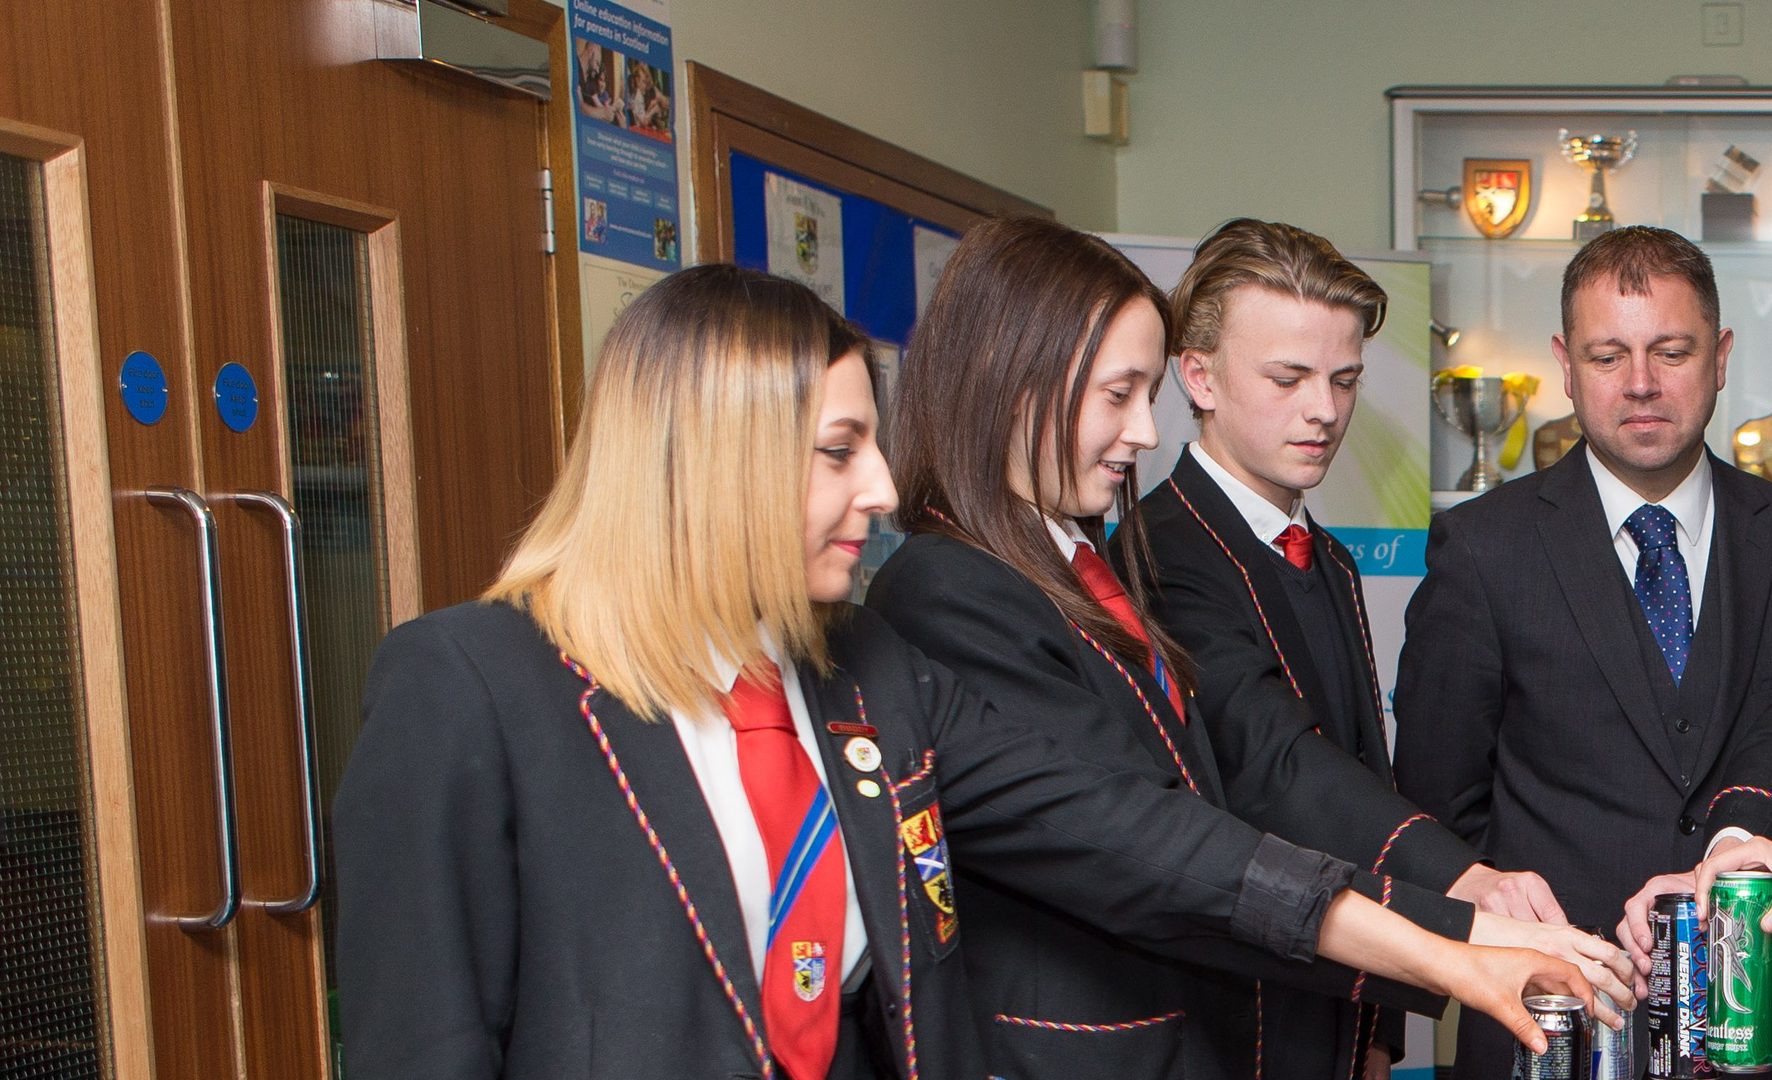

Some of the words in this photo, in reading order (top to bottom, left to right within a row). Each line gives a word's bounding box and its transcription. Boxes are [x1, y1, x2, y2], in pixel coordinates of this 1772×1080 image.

[574, 0, 598, 16] Online
[598, 8, 632, 31] education
[632, 20, 669, 46] information
[574, 13, 586, 28] for
[586, 21, 613, 40] parents
[613, 29, 622, 42] in
[622, 32, 650, 54] Scotland
[1373, 534, 1406, 569] of
[1679, 942, 1691, 1007] ENERGY
[1679, 1007, 1691, 1058] DRINK
